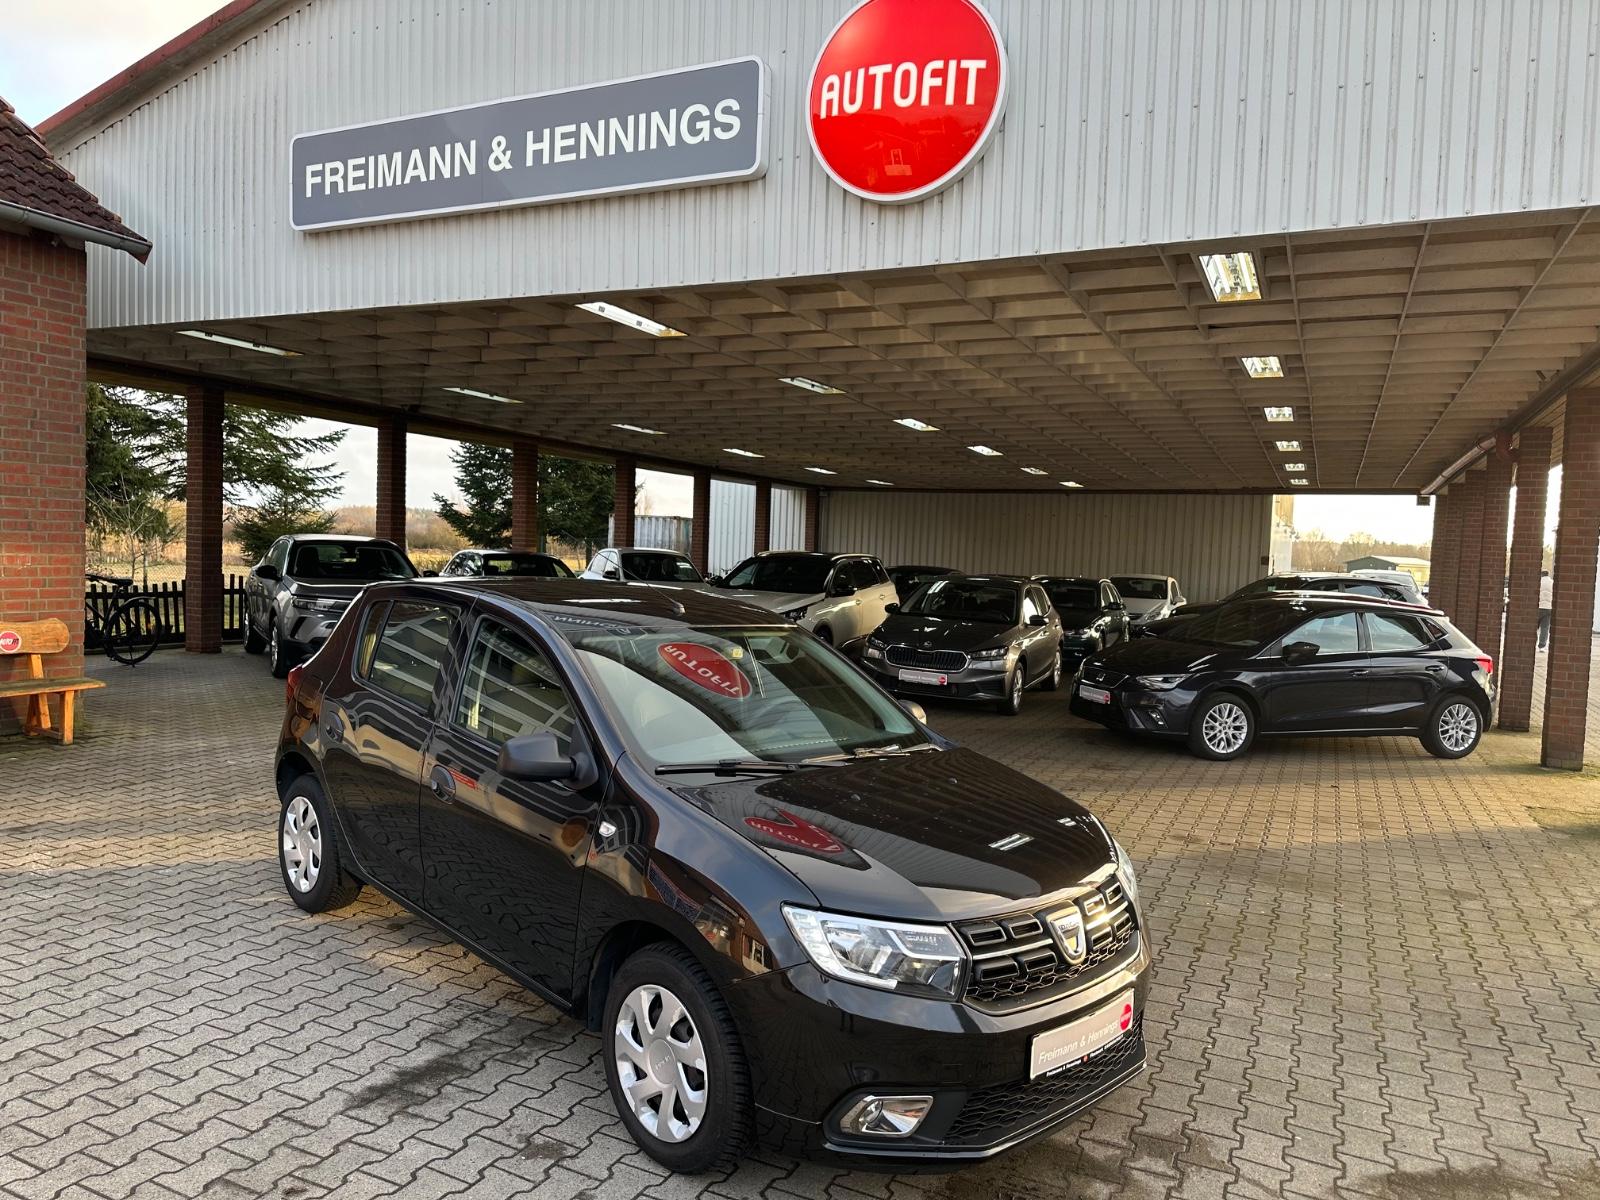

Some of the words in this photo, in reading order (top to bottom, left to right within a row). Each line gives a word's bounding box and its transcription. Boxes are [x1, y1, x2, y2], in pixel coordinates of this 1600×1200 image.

[820, 59, 987, 120] AUTOFIT
[305, 140, 477, 198] FREIMANN
[488, 135, 513, 172] &
[525, 98, 742, 167] HENNINGS
[1038, 1041, 1079, 1065] Freimann
[1079, 1035, 1087, 1048] &
